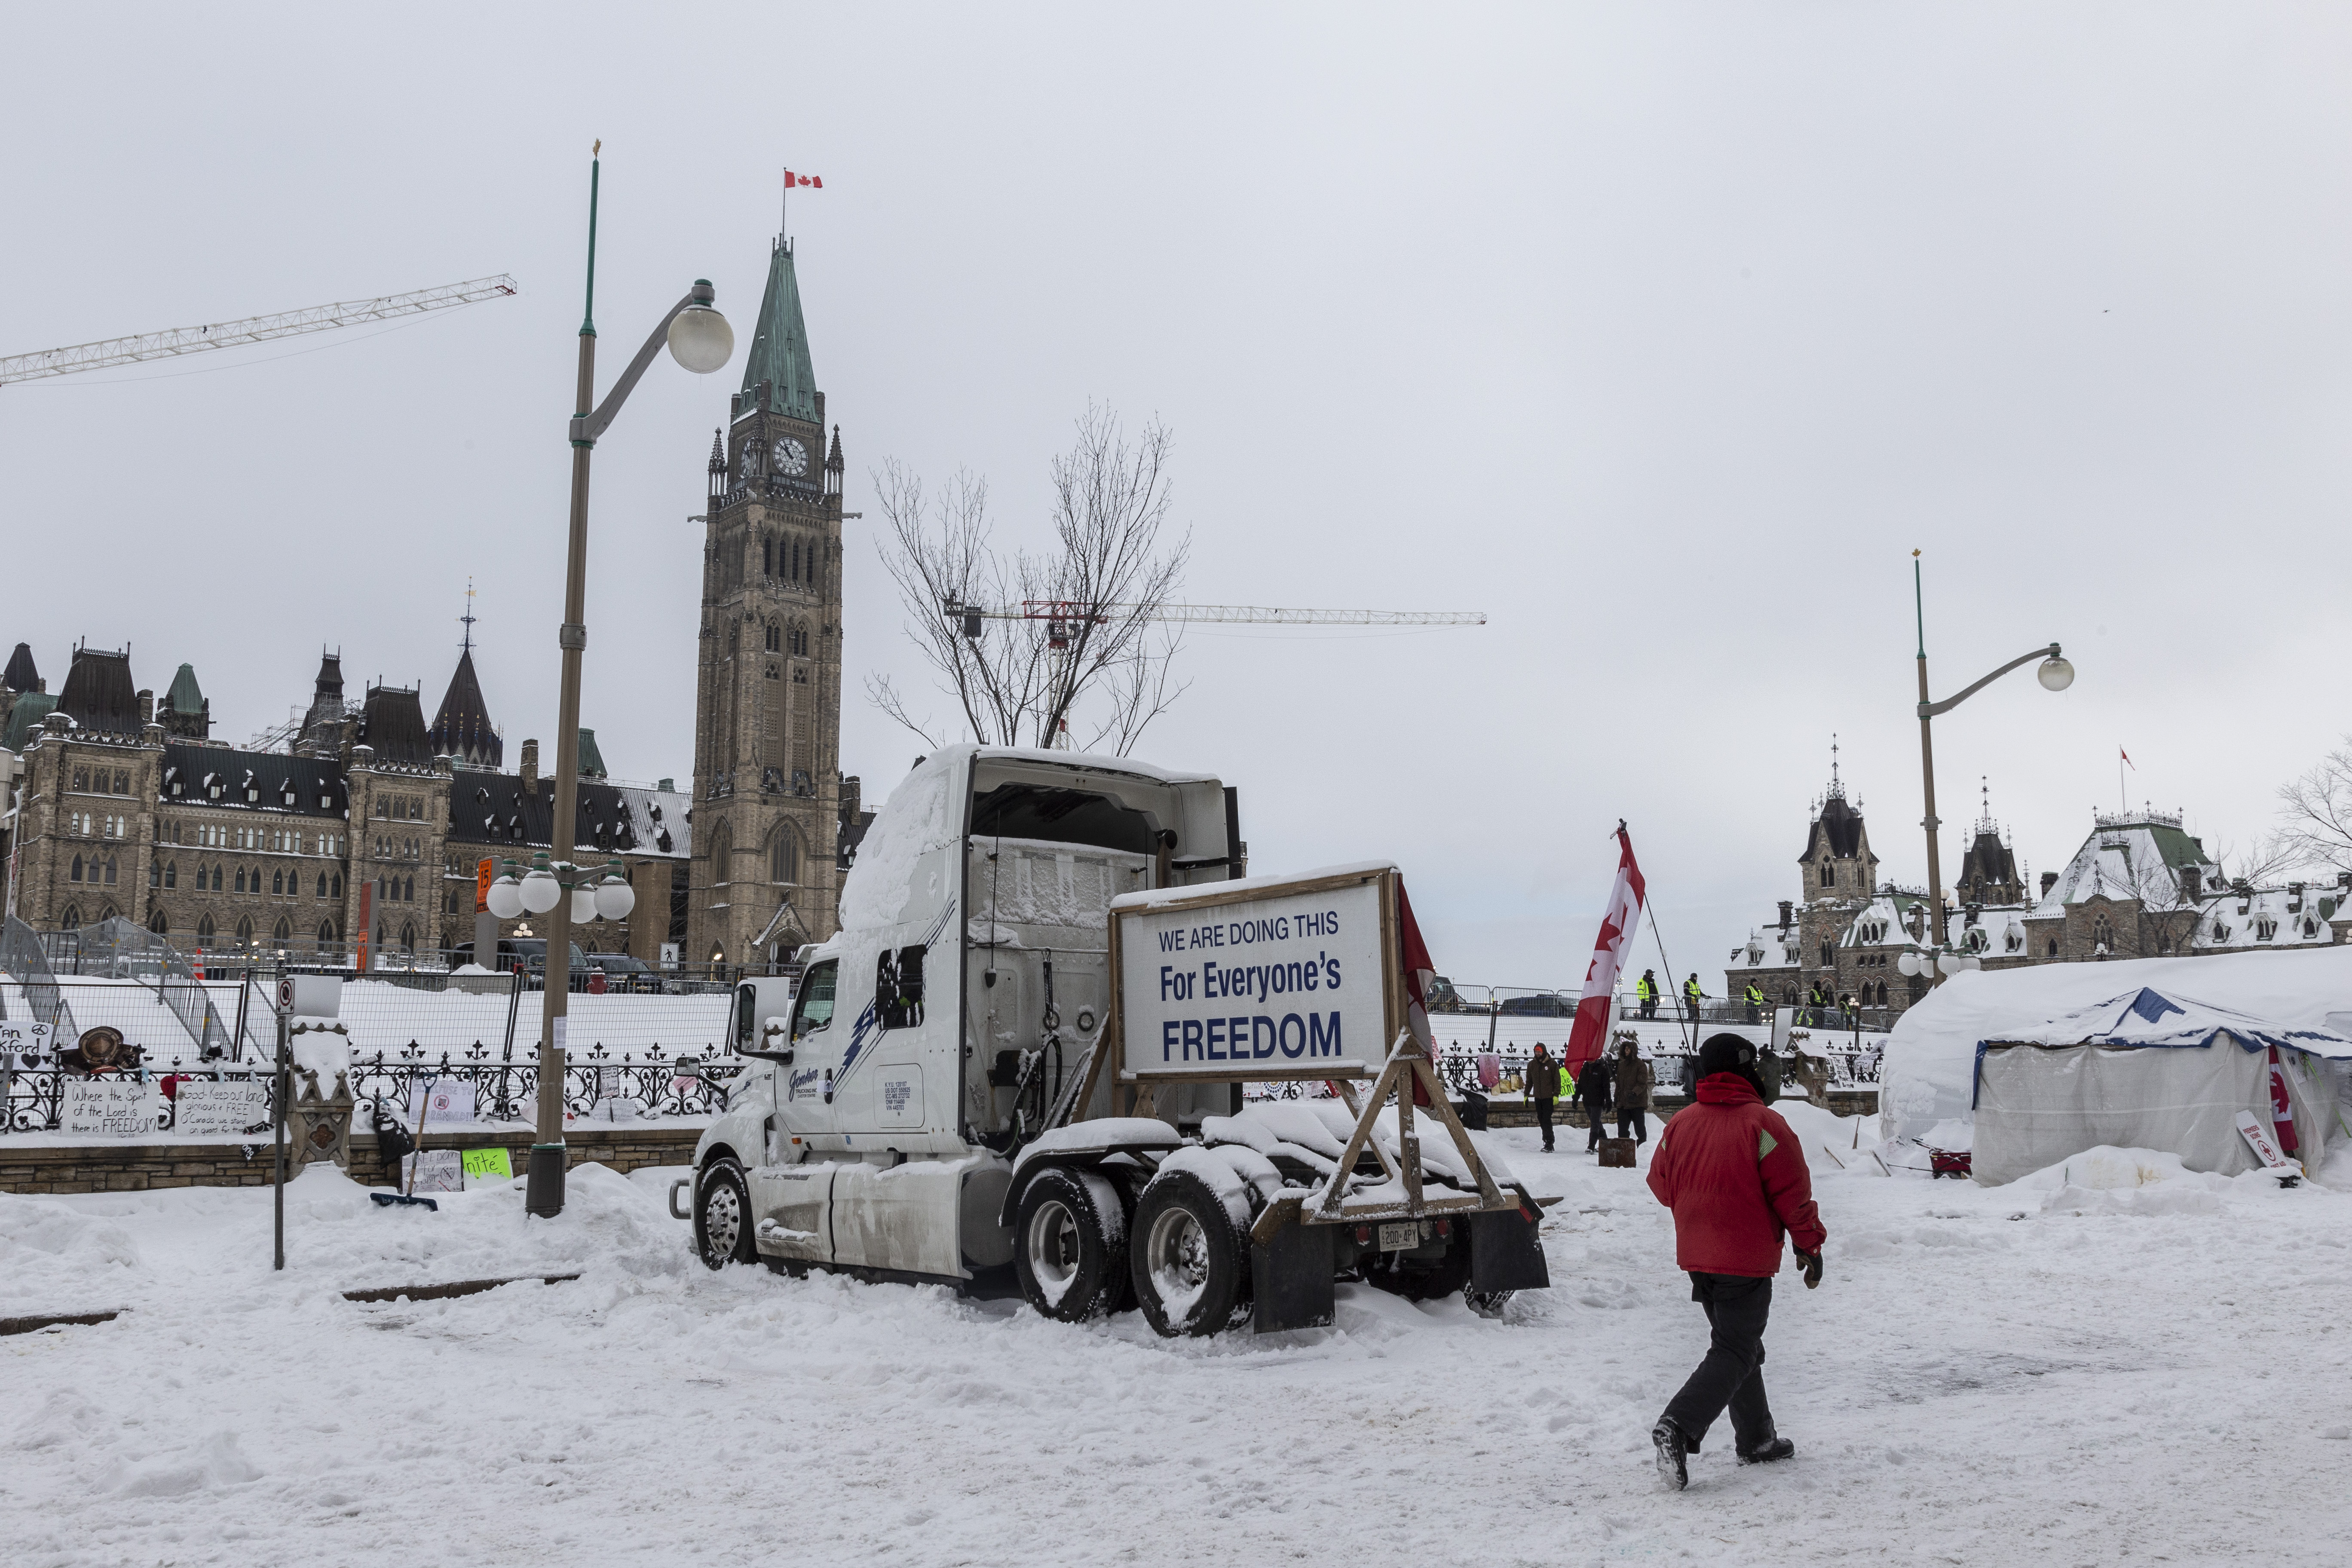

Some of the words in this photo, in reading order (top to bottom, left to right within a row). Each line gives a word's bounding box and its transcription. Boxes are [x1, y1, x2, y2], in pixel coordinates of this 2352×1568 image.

[481, 869, 489, 889] 15
[1158, 930, 1185, 952] WE
[1190, 925, 1225, 949] ARE
[1230, 917, 1289, 946] DOING
[1293, 910, 1339, 938] THIS
[1161, 965, 1196, 1001] For
[1204, 951, 1341, 1003] Everyone's
[1163, 1011, 1342, 1062] FREEDOM
[789, 1067, 818, 1102] Jonker
[1561, 1075, 1570, 1084] Die
[72, 1085, 103, 1101] Where
[109, 1087, 123, 1101] the
[126, 1088, 147, 1106] Spirit
[230, 1091, 243, 1101] our
[245, 1084, 266, 1102] land
[414, 1084, 424, 1093] I
[461, 1087, 474, 1096] TO
[74, 1103, 85, 1116] of
[88, 1104, 102, 1117] the
[107, 1104, 127, 1117] Lord
[130, 1109, 138, 1117] is
[184, 1101, 216, 1114] glorious
[71, 1122, 90, 1133] there
[92, 1124, 99, 1133] is
[103, 1118, 157, 1133] FREEDOM
[189, 1114, 215, 1124] Canada
[201, 1124, 218, 1136] guard
[221, 1125, 230, 1133] for
[412, 1151, 458, 1166] REEDOM
[1385, 1230, 1399, 1244] 200
[1404, 1229, 1416, 1242] 4PY
